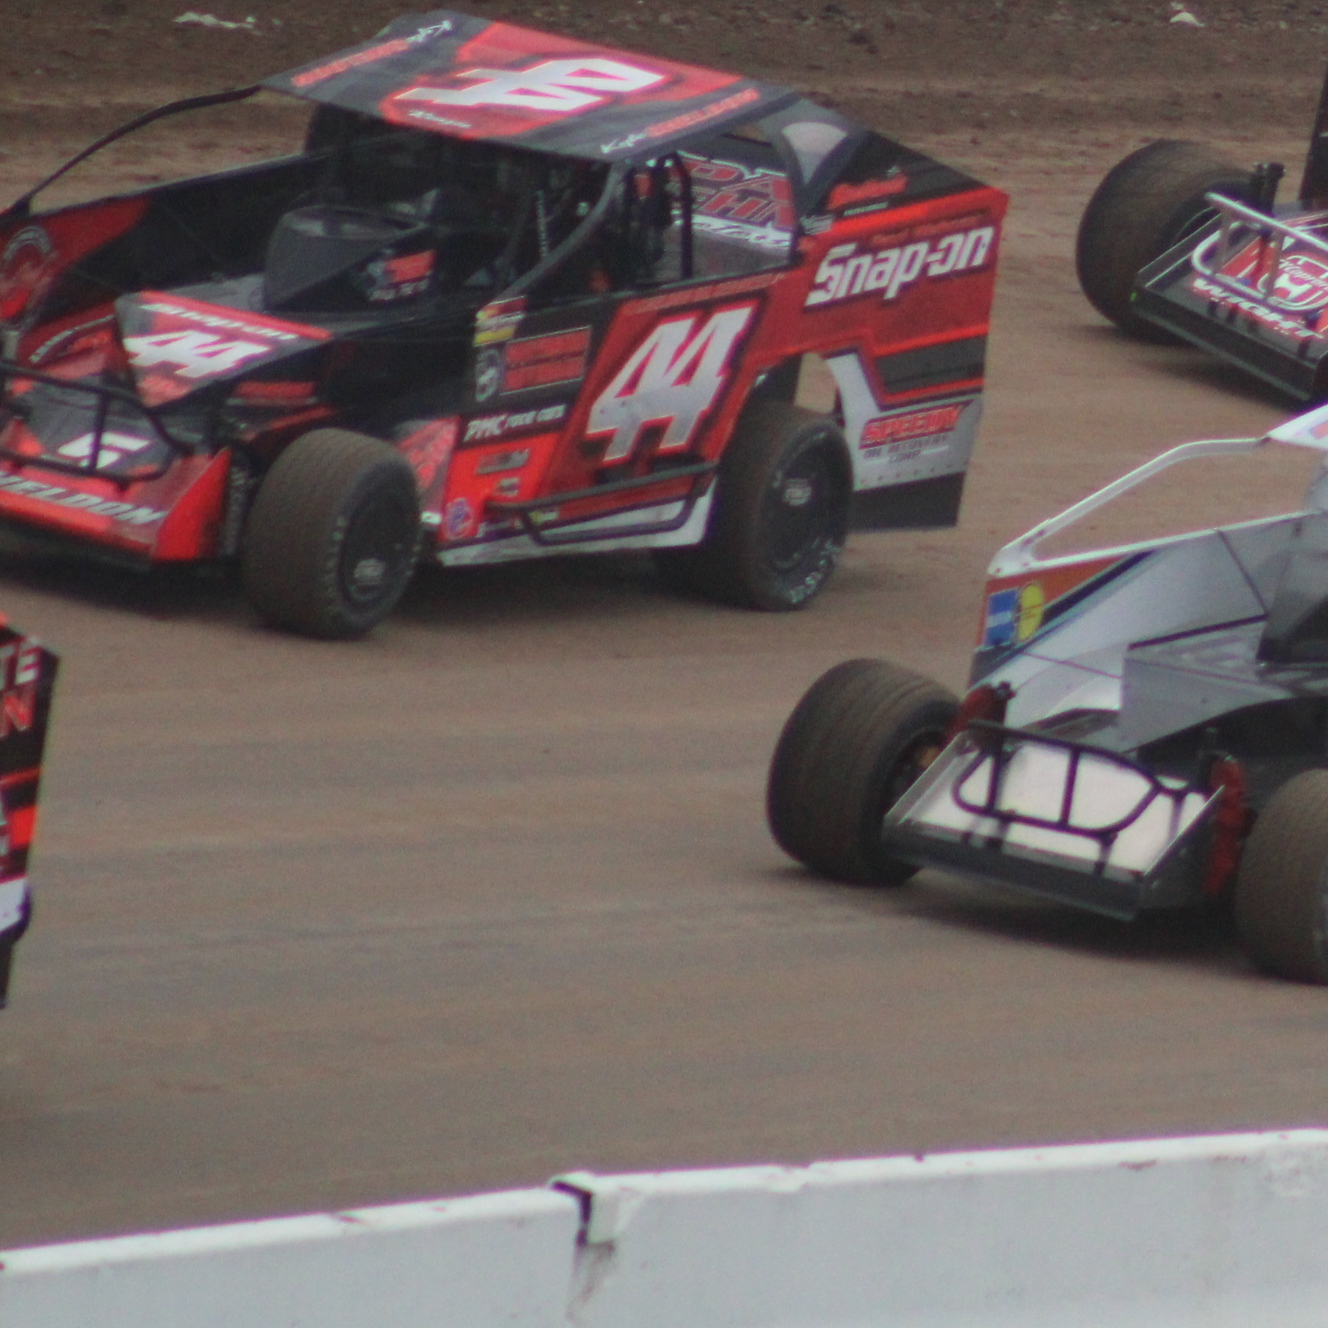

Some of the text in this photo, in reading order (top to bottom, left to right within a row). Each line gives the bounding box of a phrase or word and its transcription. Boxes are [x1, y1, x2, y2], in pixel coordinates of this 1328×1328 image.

[804, 226, 994, 307] Snap-on
[586, 300, 758, 459] 44
[464, 413, 508, 441] PMC
[0, 472, 168, 524] ELDON
